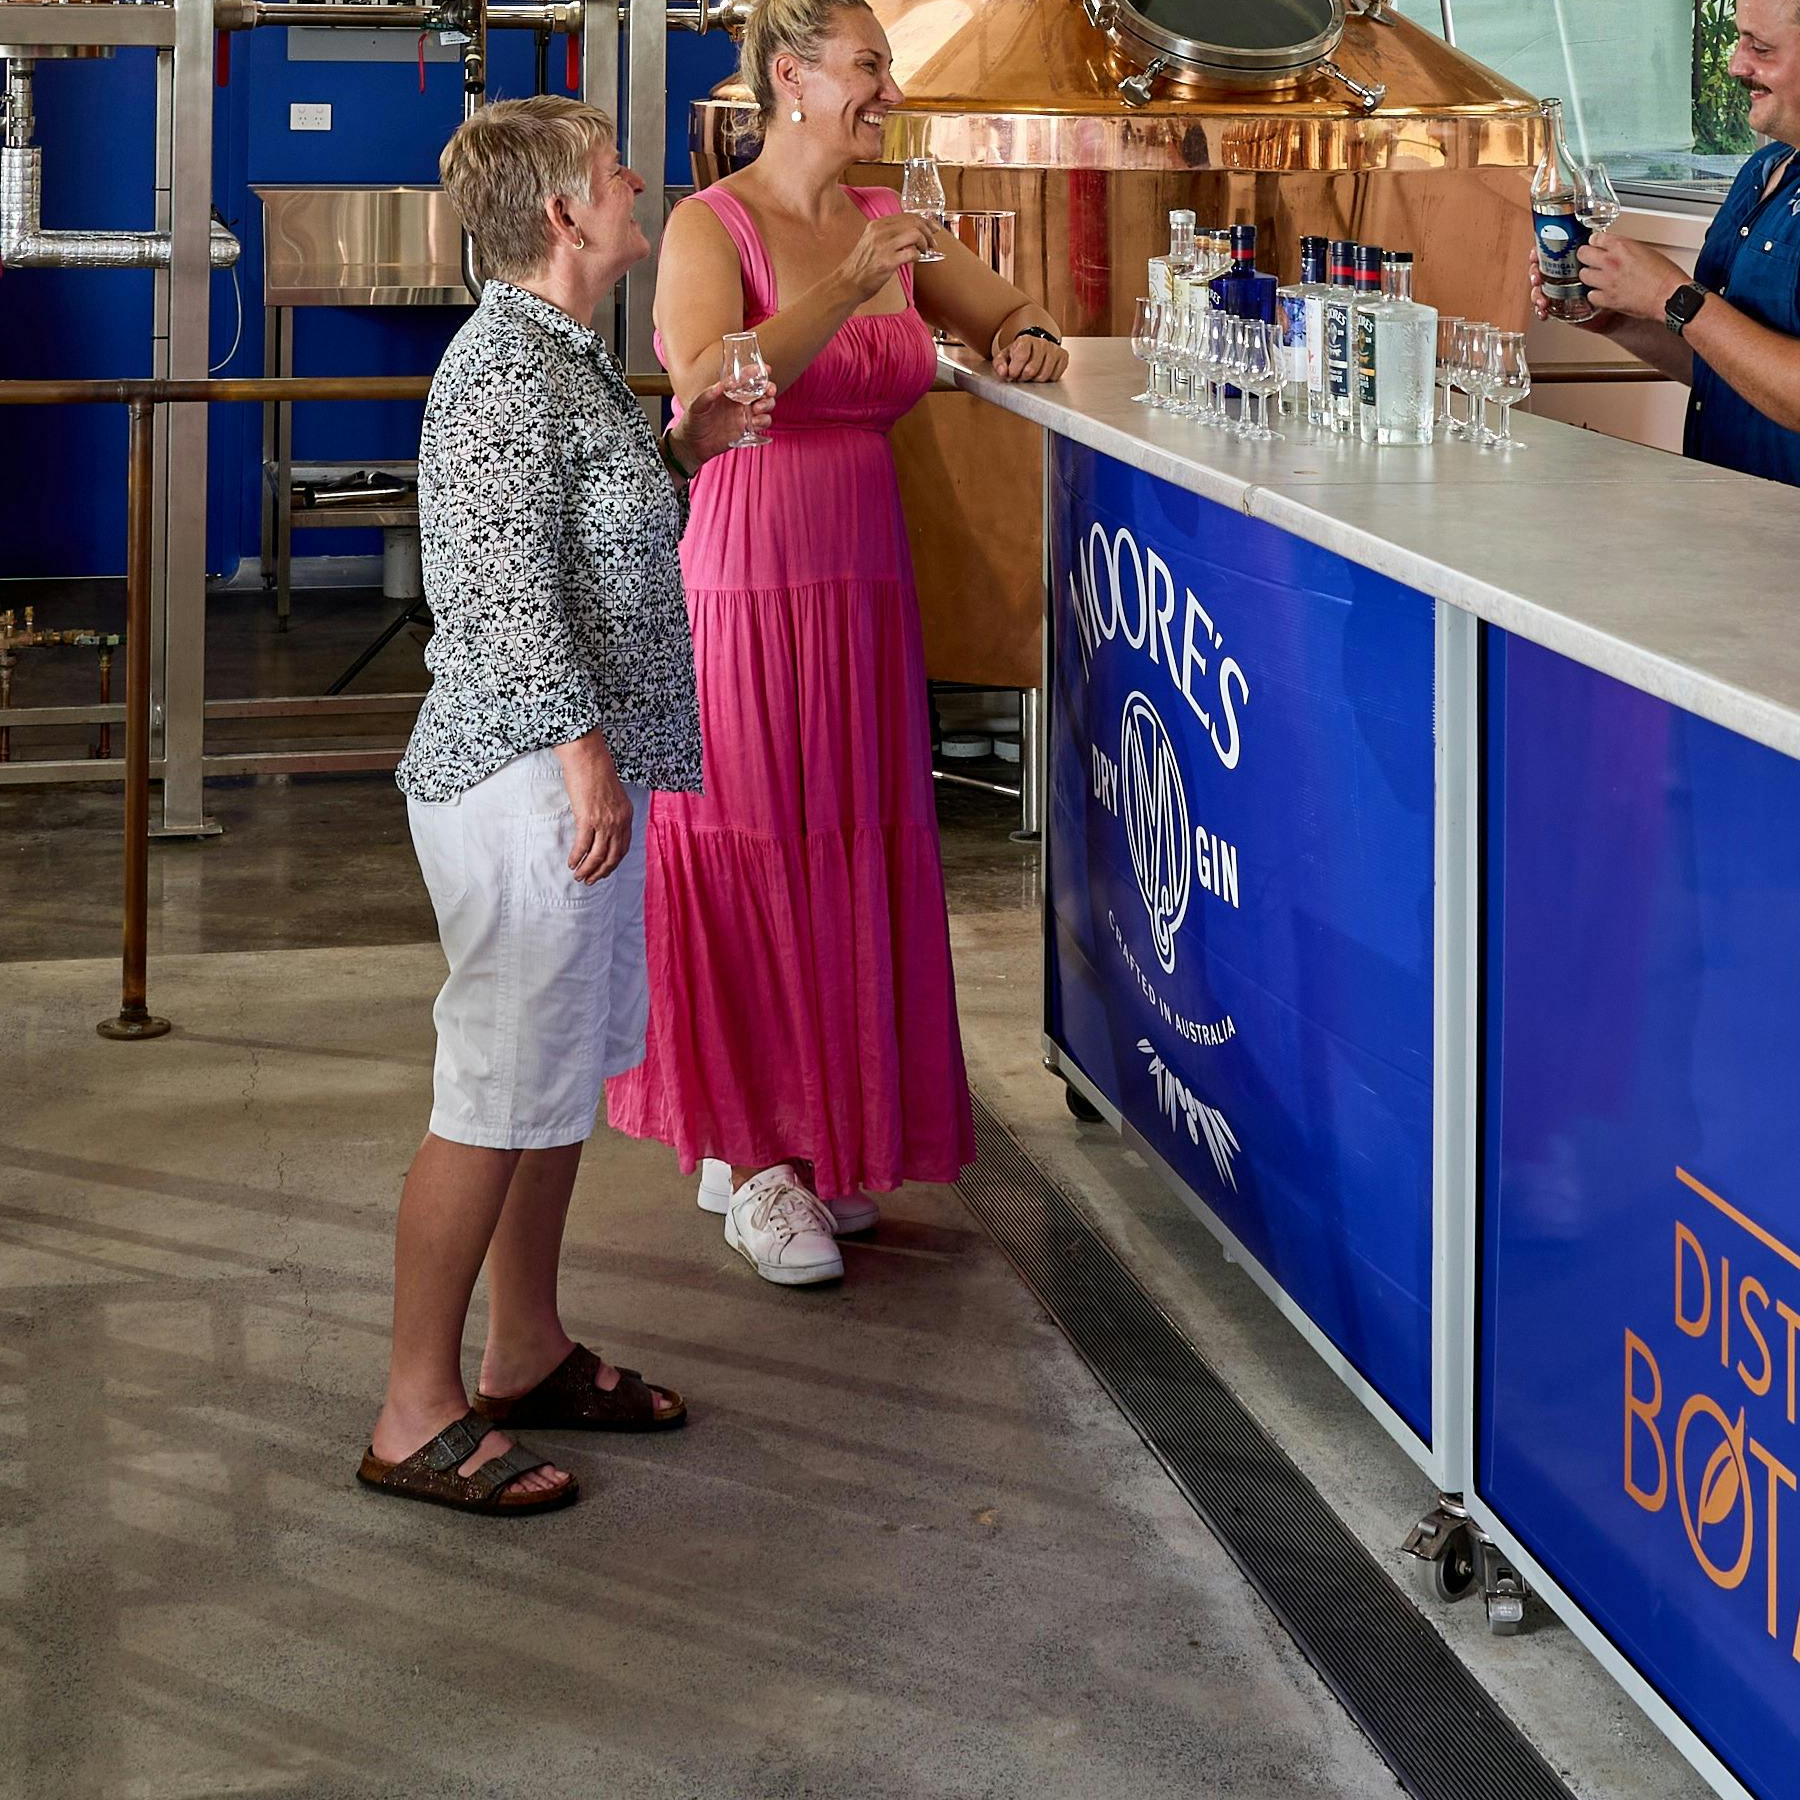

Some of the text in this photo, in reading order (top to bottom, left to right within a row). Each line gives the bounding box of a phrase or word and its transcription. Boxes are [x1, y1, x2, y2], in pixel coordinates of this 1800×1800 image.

[1068, 521, 1250, 770] MOORE'S
[1092, 743, 1118, 817] DRY
[1195, 825, 1240, 909] GIN
[1108, 909, 1236, 1046] CRAFTED IN AUSTRALIA
